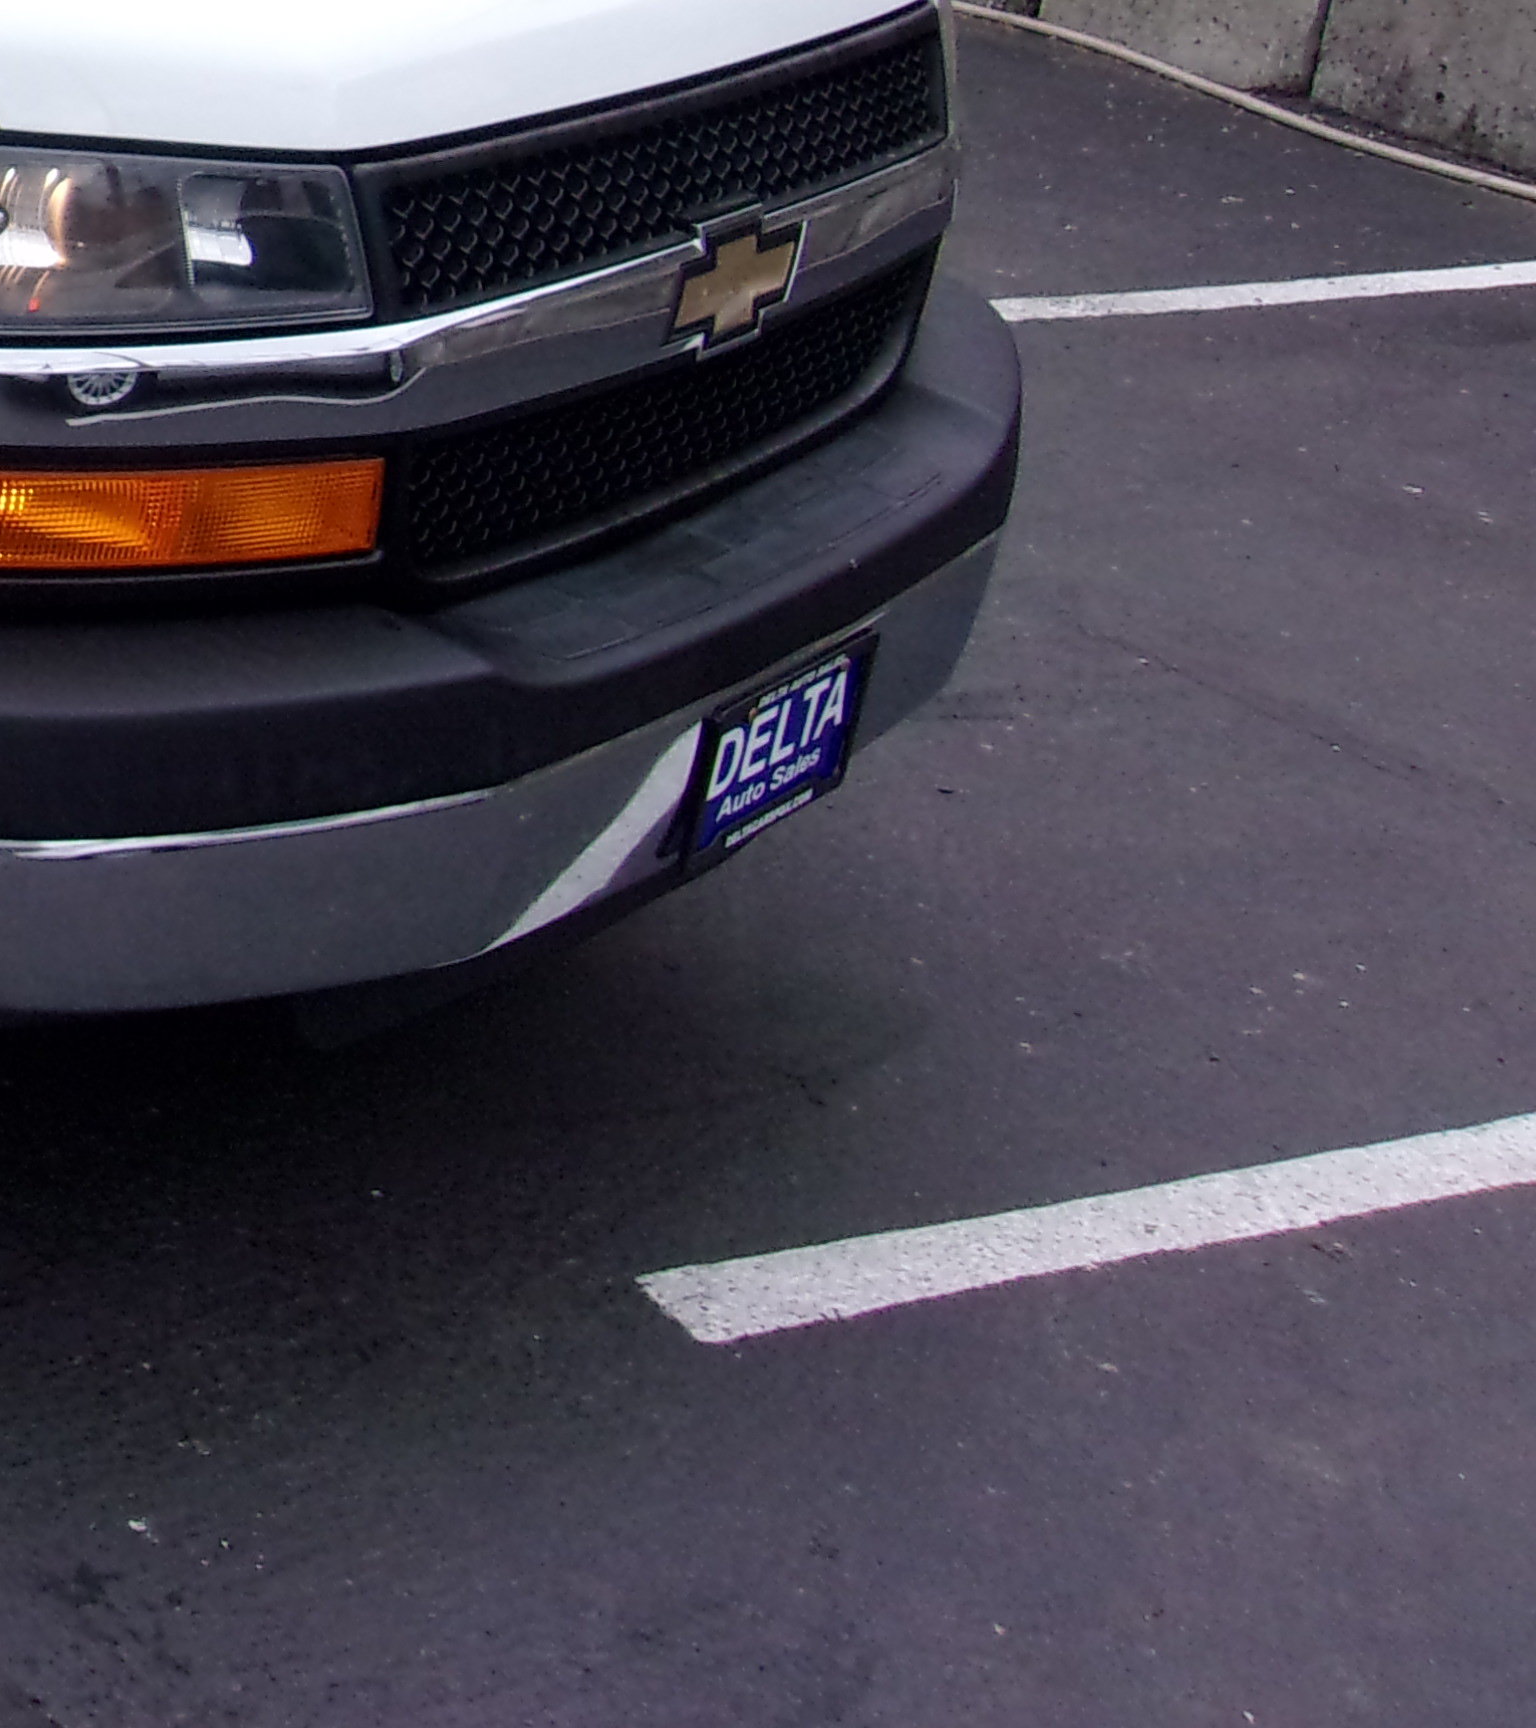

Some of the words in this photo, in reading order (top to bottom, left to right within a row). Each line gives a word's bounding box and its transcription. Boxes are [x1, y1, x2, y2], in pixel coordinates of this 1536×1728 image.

[705, 670, 848, 802] DELTA
[715, 782, 766, 823] Auto
[769, 747, 822, 790] Sales
